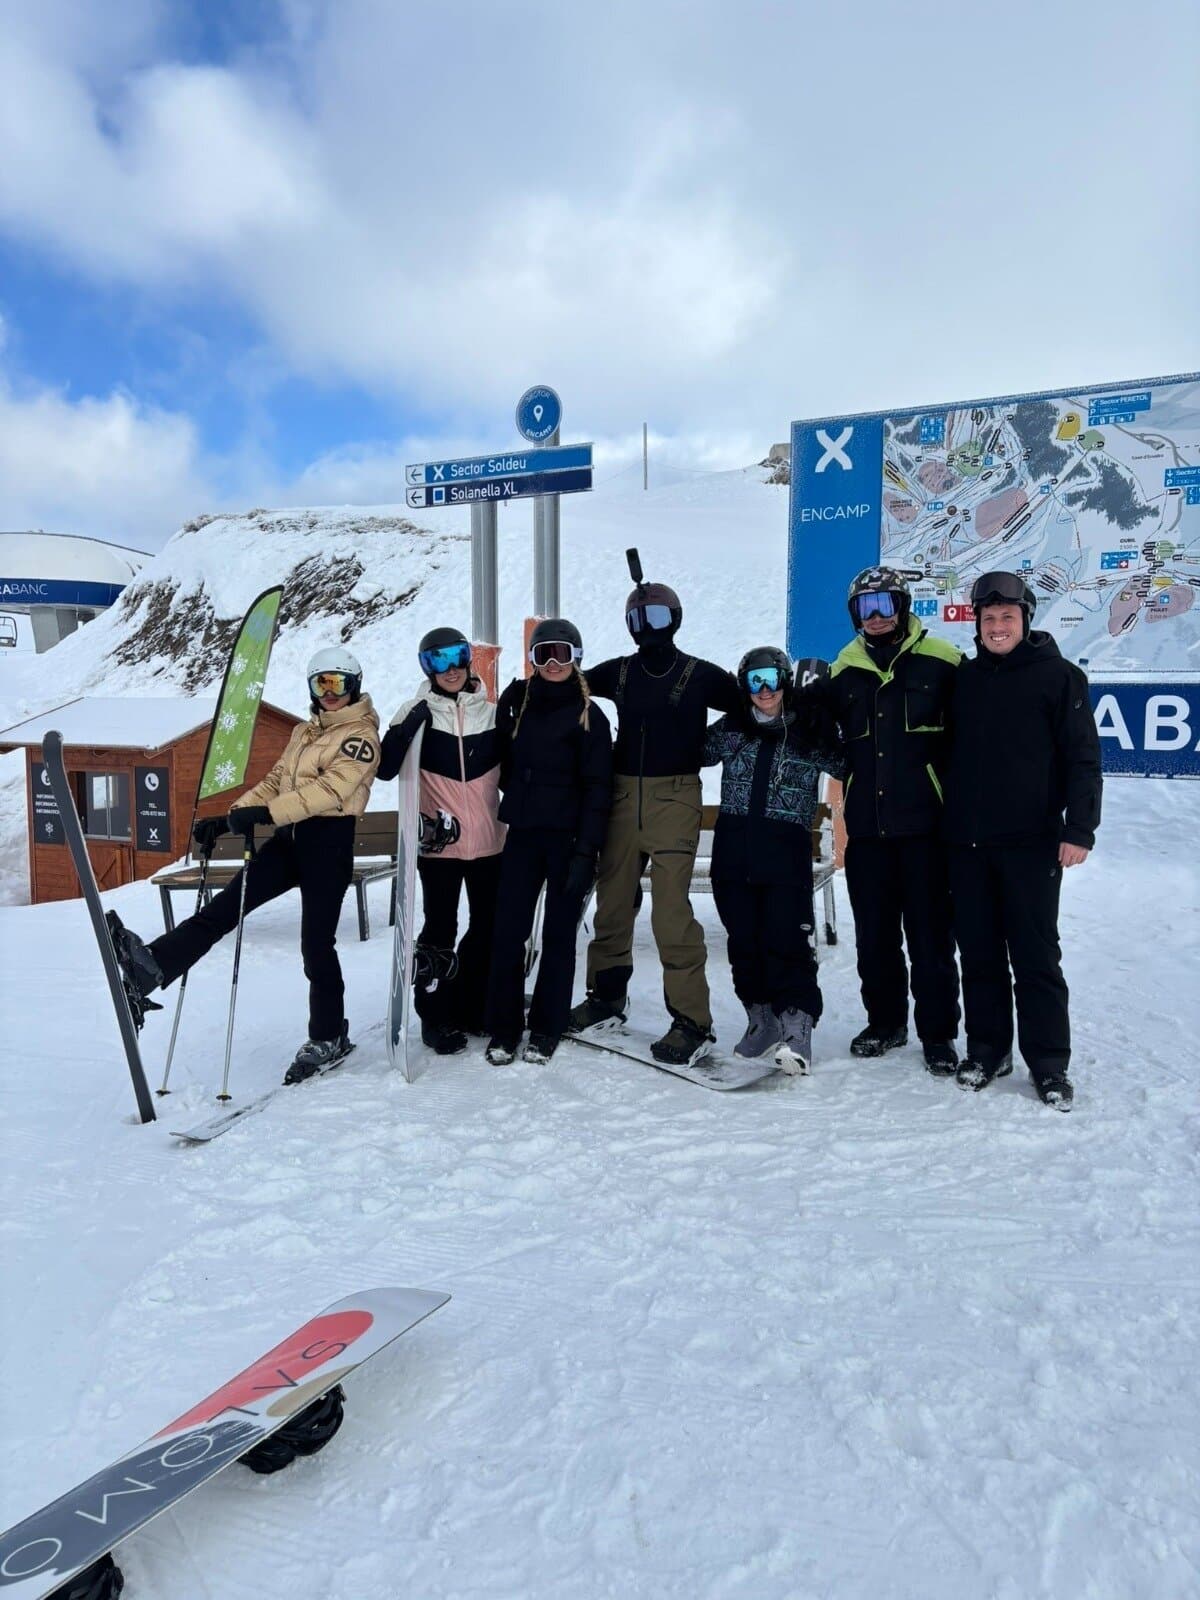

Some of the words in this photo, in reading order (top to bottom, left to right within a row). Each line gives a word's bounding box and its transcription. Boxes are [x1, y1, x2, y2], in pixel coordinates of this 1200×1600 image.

[526, 424, 553, 437] ENCAMP
[451, 462, 485, 477] Sector
[488, 458, 527, 472] Soldeu
[451, 483, 500, 501] Solanella
[503, 481, 518, 496] XL
[801, 504, 870, 522] ENCAMP
[0, 583, 48, 596] ABANC
[1093, 694, 1200, 752] AB
